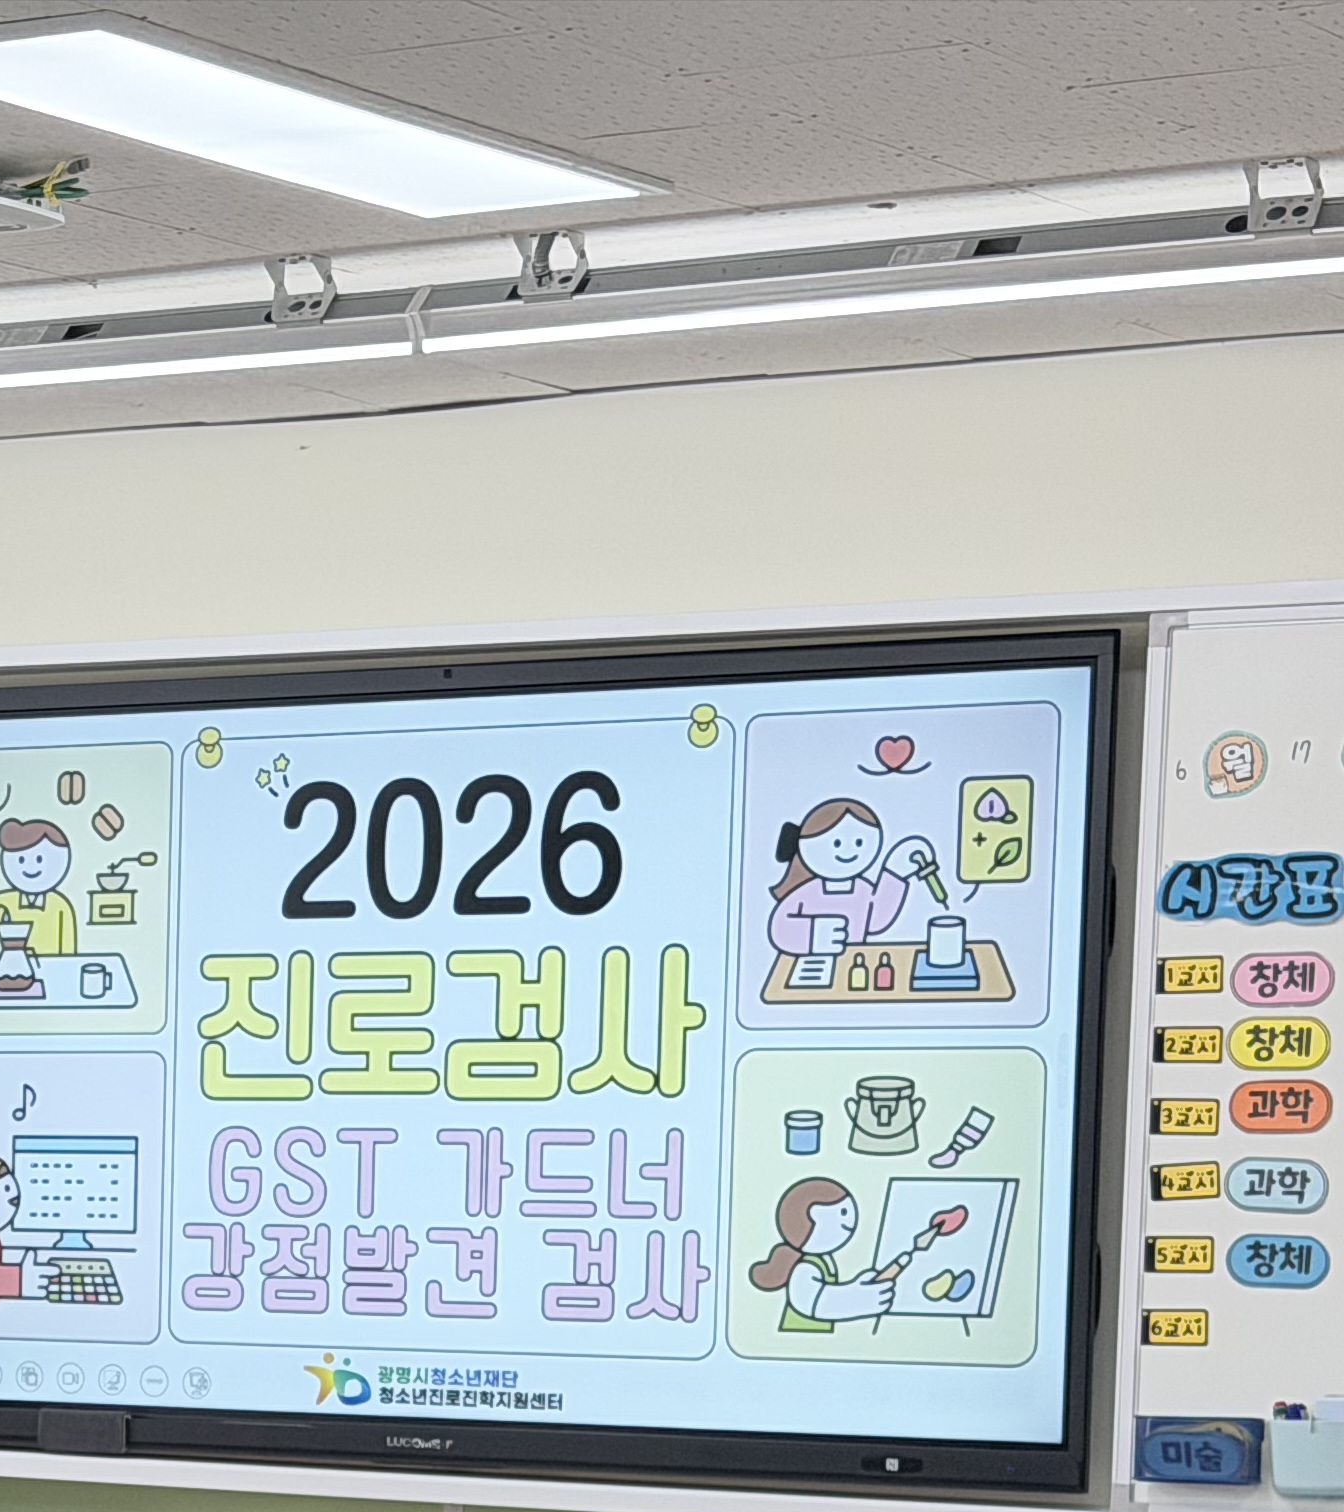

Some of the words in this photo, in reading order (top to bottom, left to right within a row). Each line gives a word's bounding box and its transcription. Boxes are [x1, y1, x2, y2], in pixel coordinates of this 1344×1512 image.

[1176, 760, 1187, 780] 6
[1220, 741, 1255, 783] 월
[1291, 740, 1312, 764] 17
[281, 769, 624, 922] 2026
[1162, 857, 1339, 920] 시간표
[1167, 965, 1218, 987] 1교시
[1248, 960, 1315, 998] 창체
[197, 943, 708, 1102] 진로검사
[1165, 1035, 1216, 1055] 2교시
[1246, 1024, 1312, 1061] 창체
[1162, 1107, 1214, 1127] 3교시
[1247, 1087, 1314, 1124] 과학
[208, 1125, 398, 1218] GST
[437, 1126, 685, 1222] 가드너
[1162, 1170, 1215, 1192] 4교시
[1243, 1166, 1311, 1204] 과학
[180, 1221, 500, 1321] 강점발견
[542, 1226, 713, 1324] 검사
[1156, 1244, 1208, 1265] 5교시
[1246, 1240, 1312, 1278] 창체
[1151, 1317, 1202, 1338] 6교시
[378, 1365, 519, 1389] 광명시청소년재단
[378, 1387, 564, 1412] 청소년진로진학지원센터
[1160, 1440, 1223, 1473] 미술
